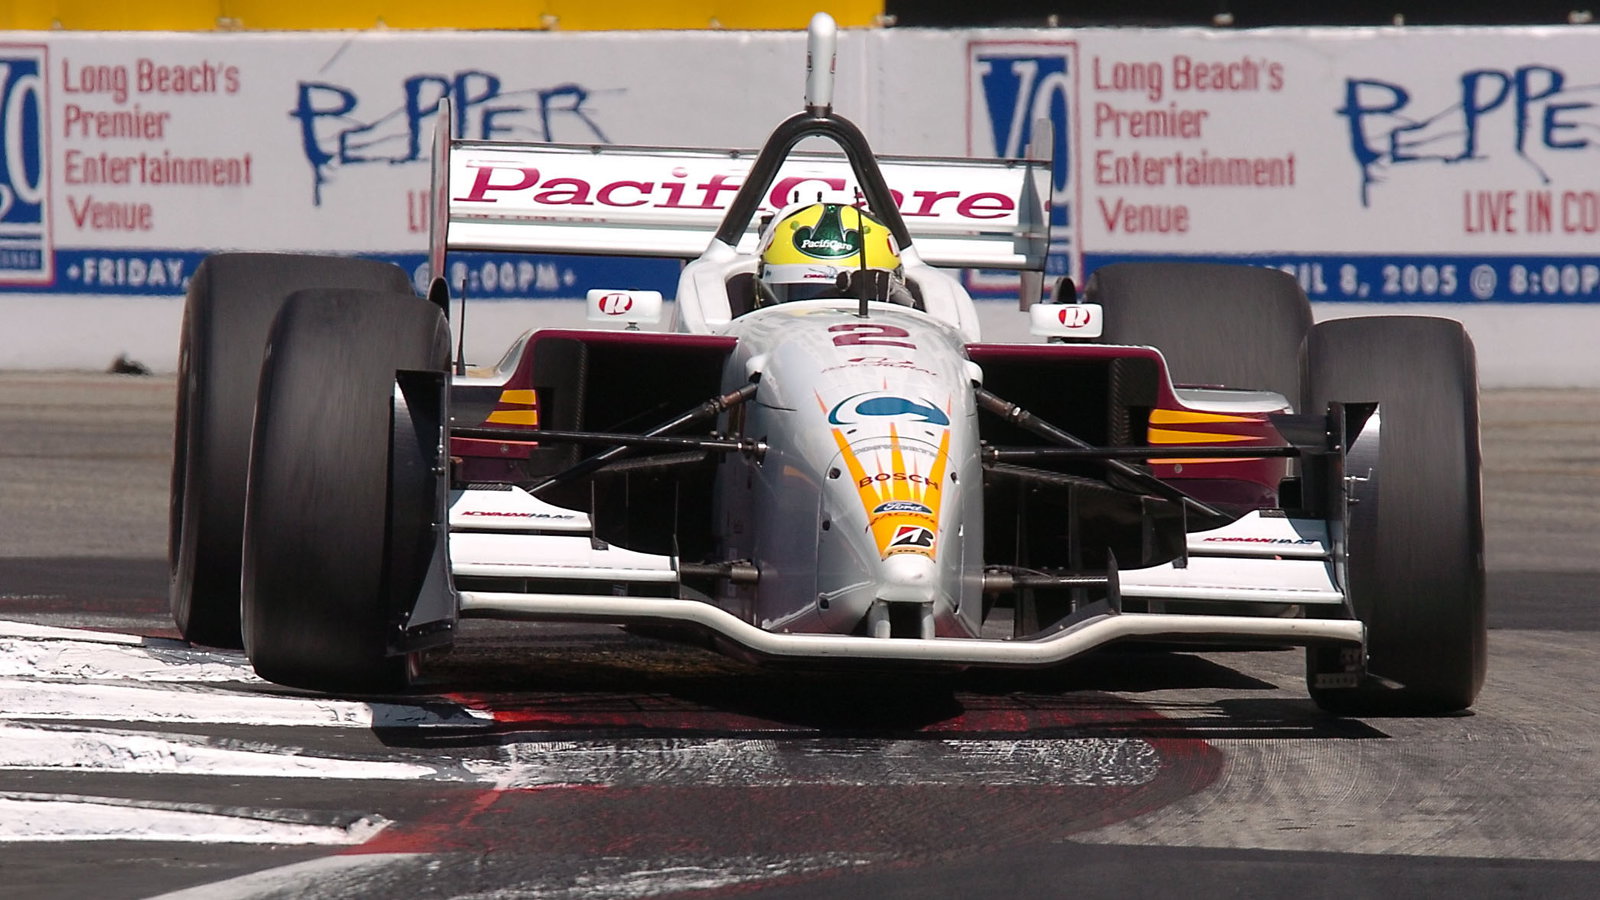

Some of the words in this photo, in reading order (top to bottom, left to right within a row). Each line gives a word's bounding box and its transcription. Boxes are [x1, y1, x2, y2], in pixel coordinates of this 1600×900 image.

[62, 58, 128, 104] Long
[136, 58, 240, 93] Beach's
[1092, 55, 1163, 101] Long
[1173, 55, 1284, 91] Beach's
[63, 104, 171, 139] Premier
[1095, 102, 1208, 138] Premier
[288, 70, 616, 207] PEPPER
[64, 149, 254, 186] Entertainment
[1095, 150, 1296, 186] Entertainment
[453, 159, 1015, 220] PacifCre
[67, 195, 154, 230] Venue
[1098, 198, 1190, 233] Venue
[1464, 190, 1516, 234] LIVE
[1526, 190, 1553, 234] IN
[1382, 264, 1458, 295] 2005
[1469, 264, 1498, 300] @
[827, 323, 918, 350] 2
[859, 472, 939, 490] BOSCH
[882, 501, 923, 512] Ford
